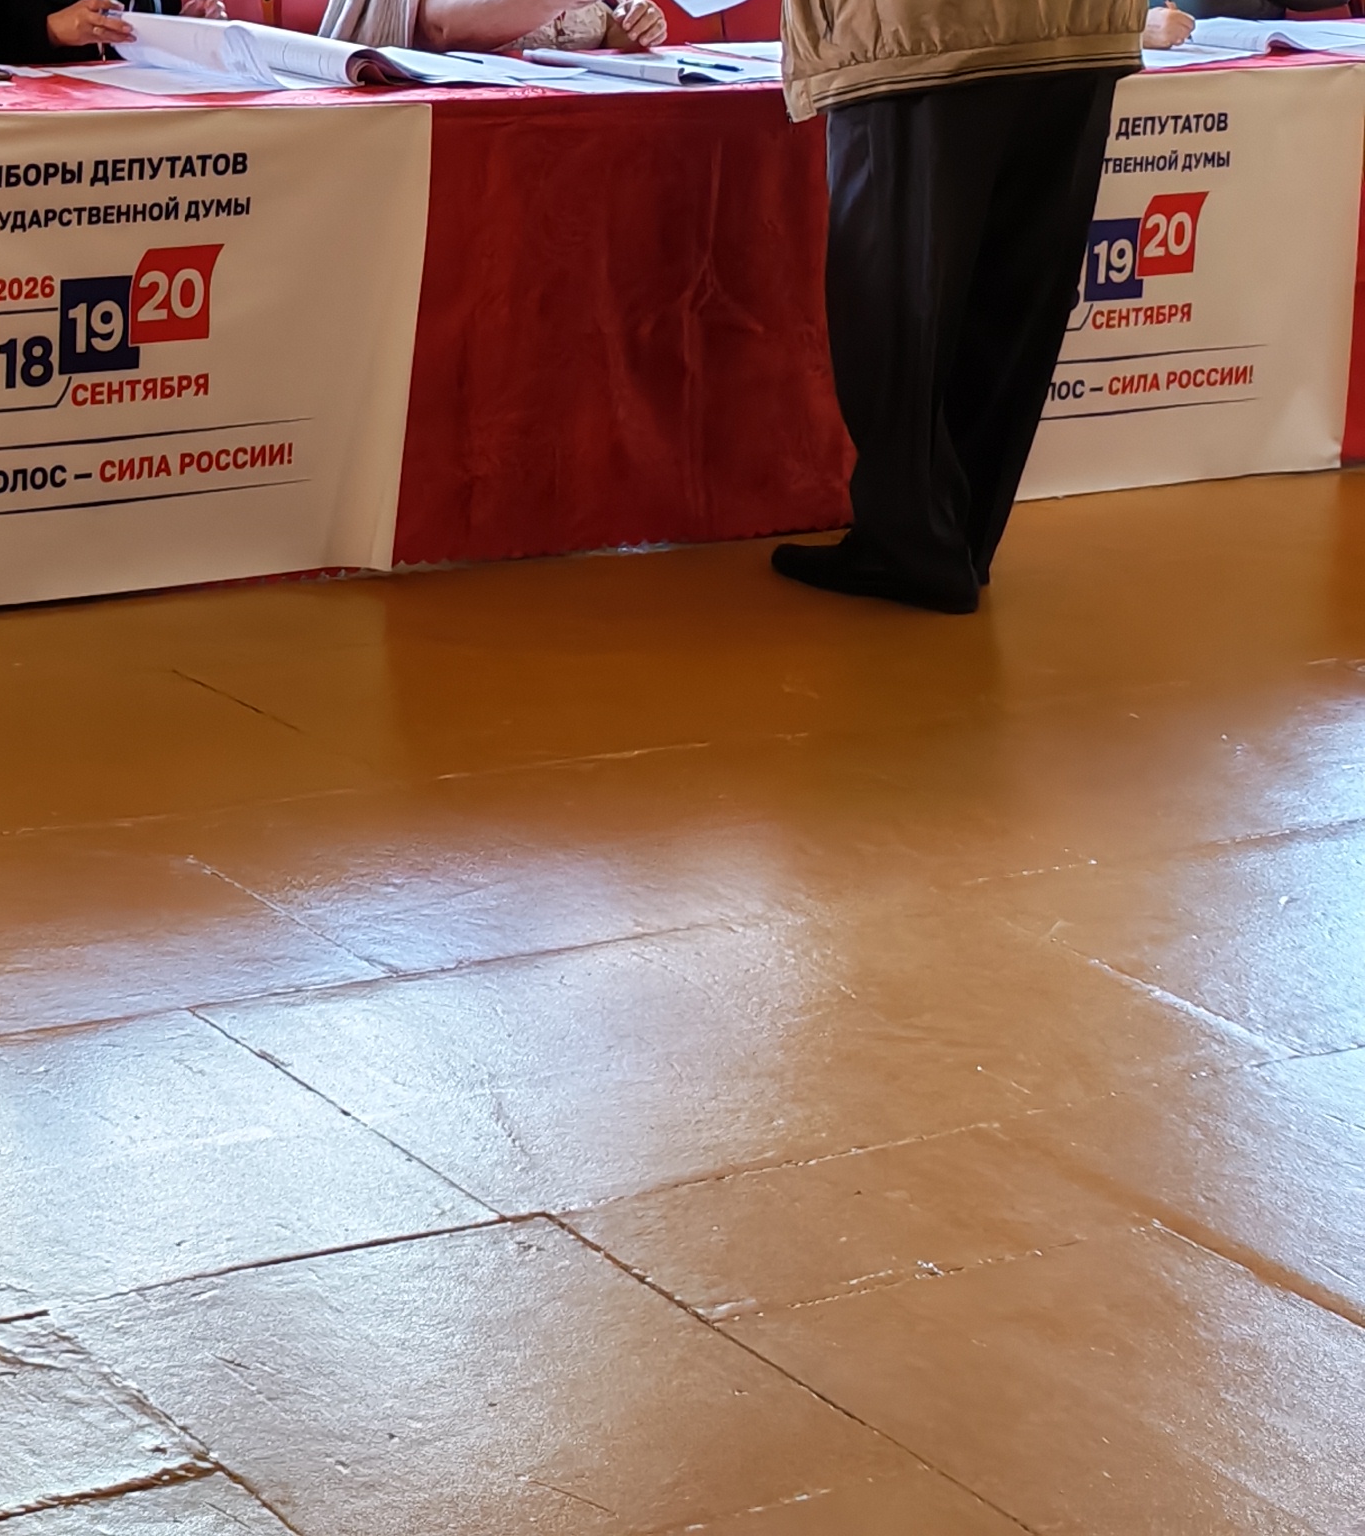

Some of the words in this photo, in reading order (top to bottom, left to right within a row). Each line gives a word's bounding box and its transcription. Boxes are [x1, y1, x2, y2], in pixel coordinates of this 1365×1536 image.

[1116, 113, 1228, 140] ДЕПУТАТОВ
[90, 153, 248, 187] ДЕПУТАТОВ
[1182, 151, 1230, 172] ДУМЫ
[185, 197, 251, 222] ДУМЫ
[1143, 212, 1192, 258] 20
[1093, 239, 1133, 285] 19
[137, 267, 204, 322] 20
[68, 300, 124, 353] 19
[1092, 303, 1192, 329] СЕНТЯБРЯ
[72, 373, 209, 406] СЕНТЯБРЯ
[1046, 380, 1085, 401] ЛОС
[1109, 373, 1160, 395] СИЛА
[1166, 365, 1253, 390] РОССИИ!
[100, 455, 171, 482] СИЛА
[180, 443, 293, 475] РОССИИ!
